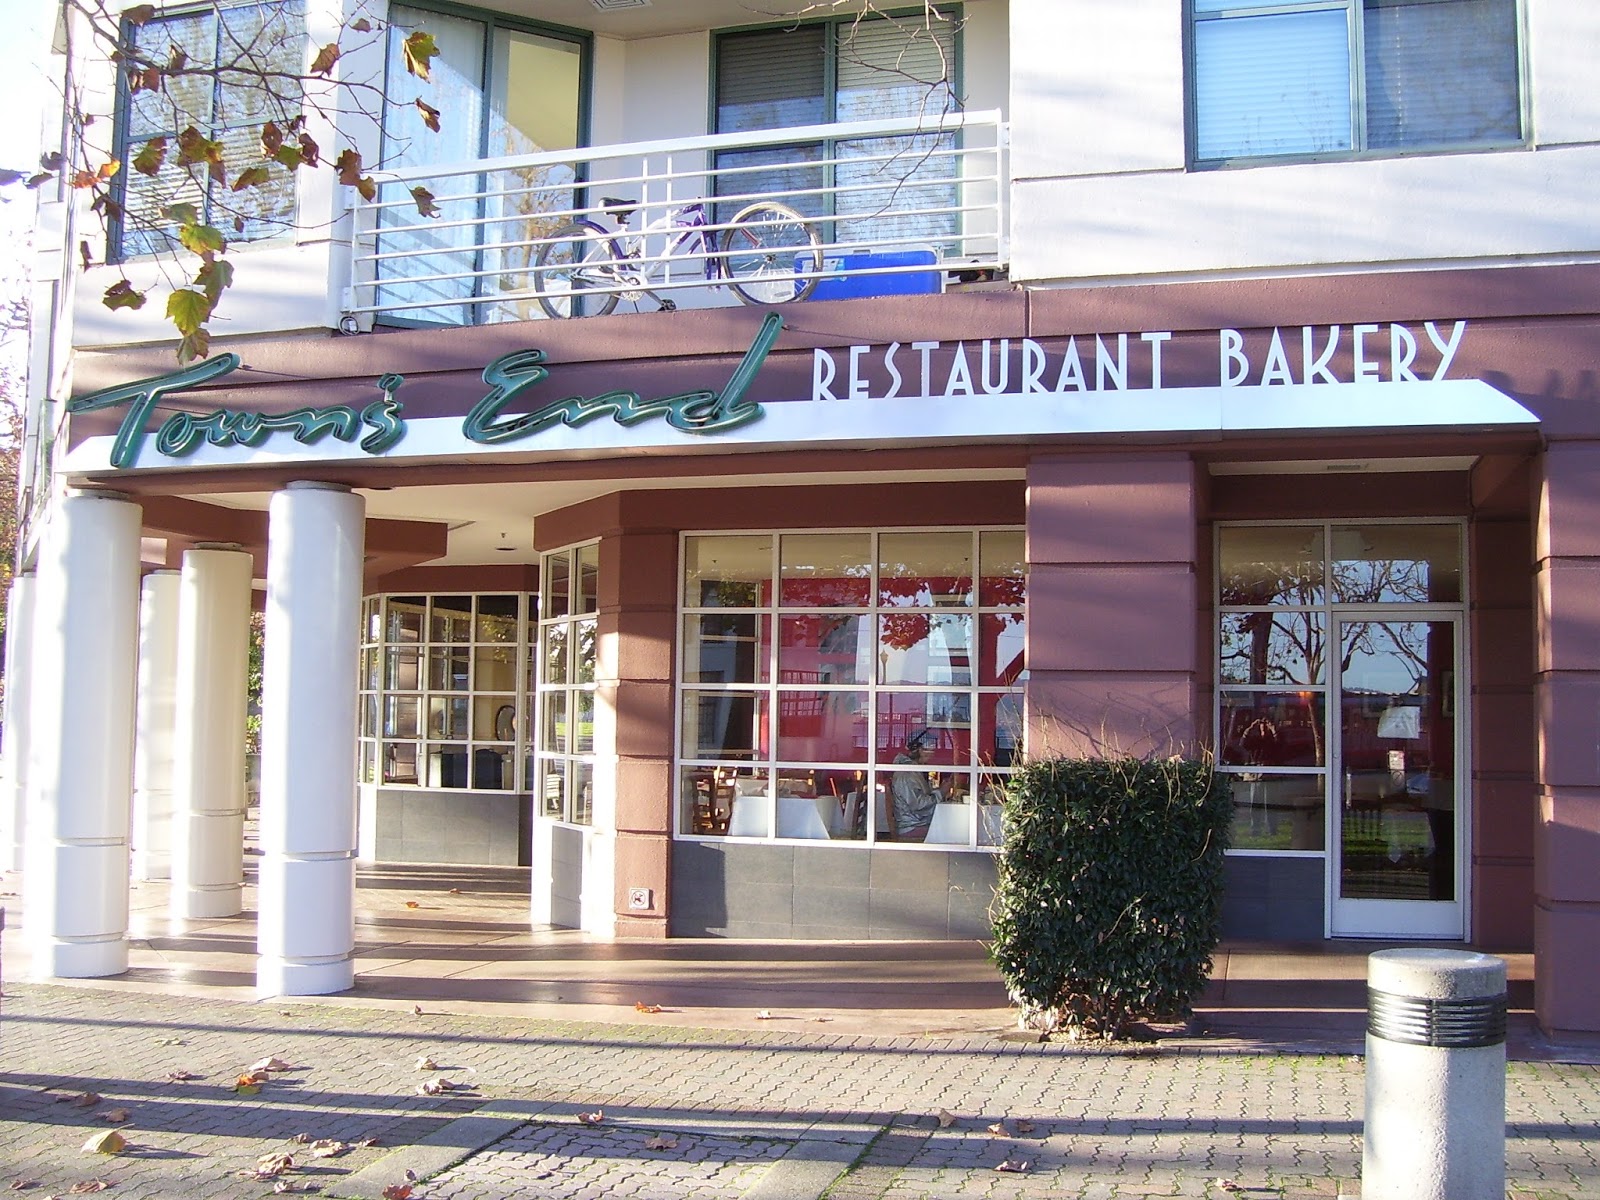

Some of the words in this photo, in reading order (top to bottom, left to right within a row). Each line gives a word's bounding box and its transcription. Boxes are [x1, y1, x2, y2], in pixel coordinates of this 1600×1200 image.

[67, 352, 406, 469] Town's
[462, 311, 784, 444] End
[812, 331, 1172, 401] RESTAURANT
[1219, 320, 1467, 387] BAKERY
